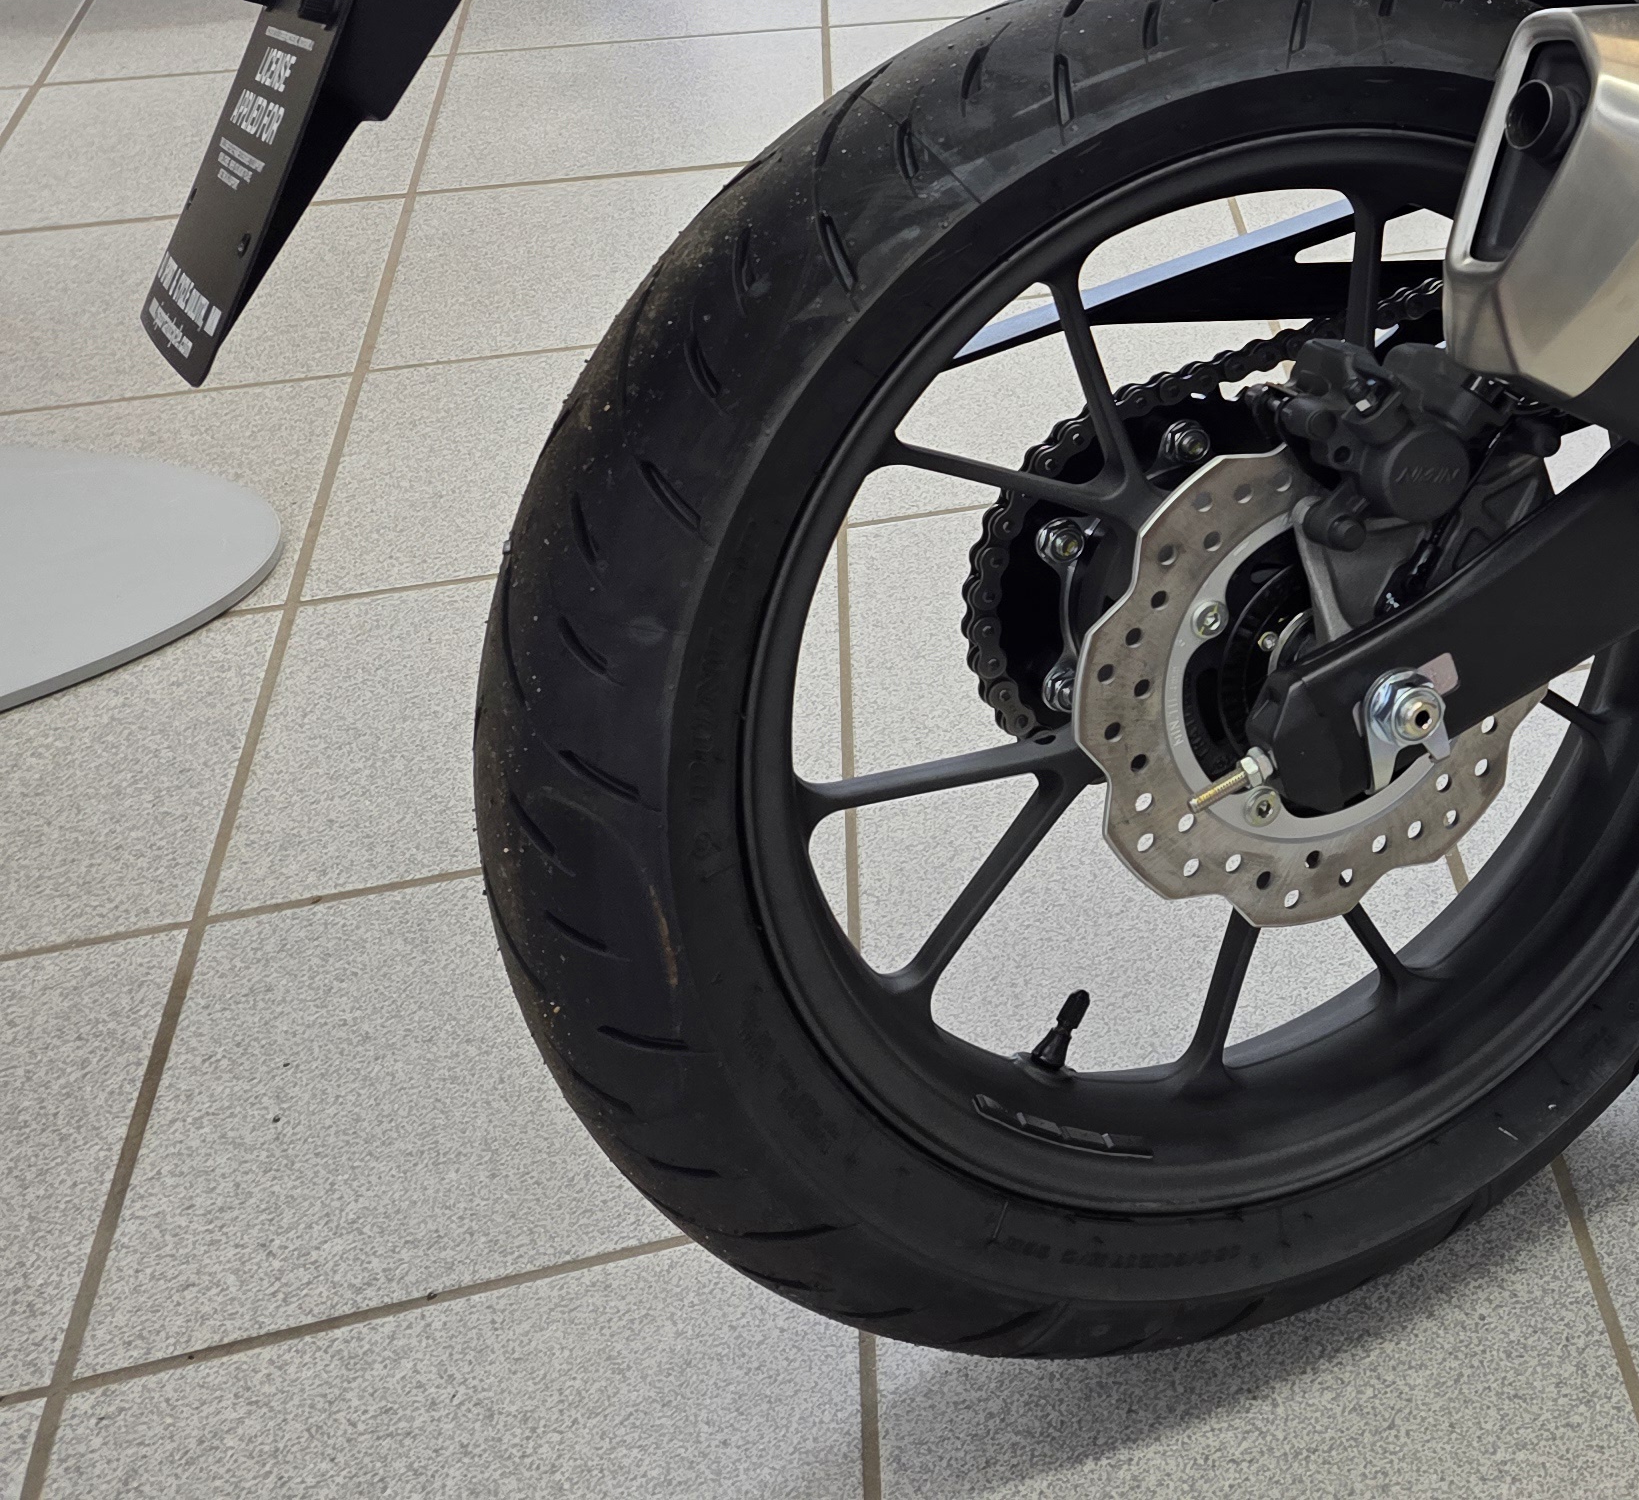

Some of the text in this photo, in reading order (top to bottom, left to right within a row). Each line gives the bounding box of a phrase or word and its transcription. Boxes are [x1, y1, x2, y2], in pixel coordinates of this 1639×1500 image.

[255, 46, 297, 92] LICENSE
[229, 88, 285, 145] APPLIED FOR
